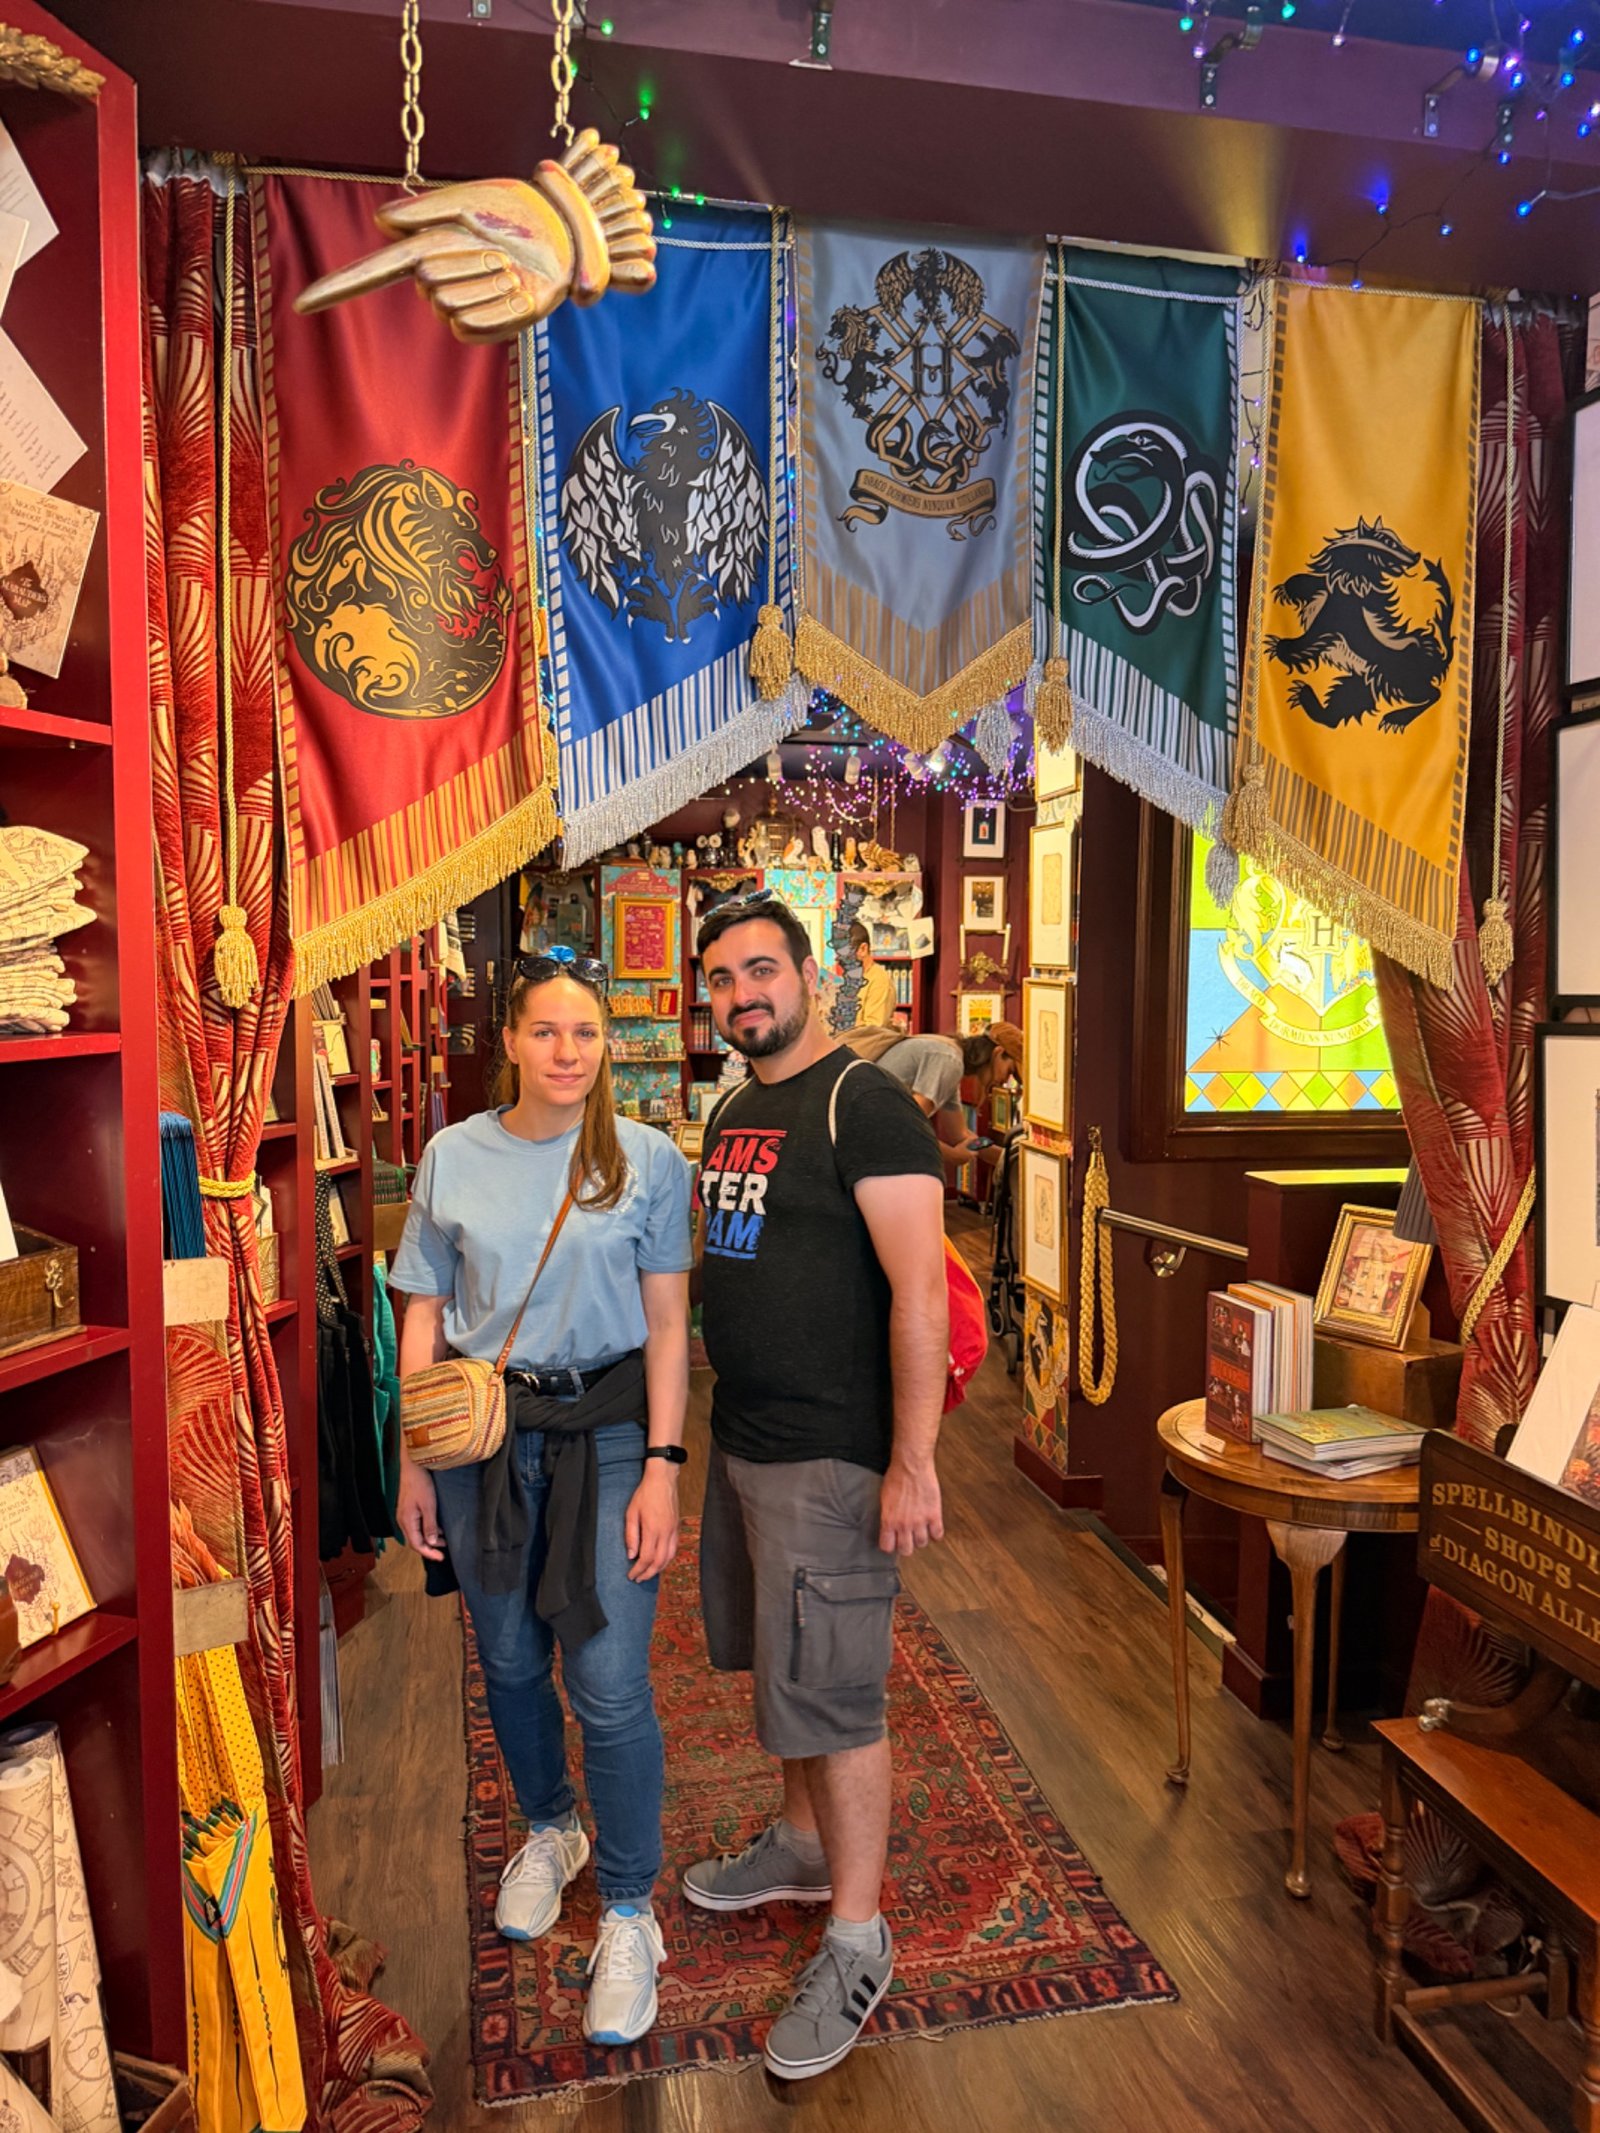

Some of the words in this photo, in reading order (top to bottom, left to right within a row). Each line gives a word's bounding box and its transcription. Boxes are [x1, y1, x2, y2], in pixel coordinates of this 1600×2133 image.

[1312, 915, 1336, 947] H
[705, 1136, 783, 1175] AMS
[701, 1171, 768, 1215] TER
[705, 1207, 765, 1251] AM
[1443, 1537, 1535, 1605] DIAGON
[1484, 1525, 1573, 1590] SHOPS
